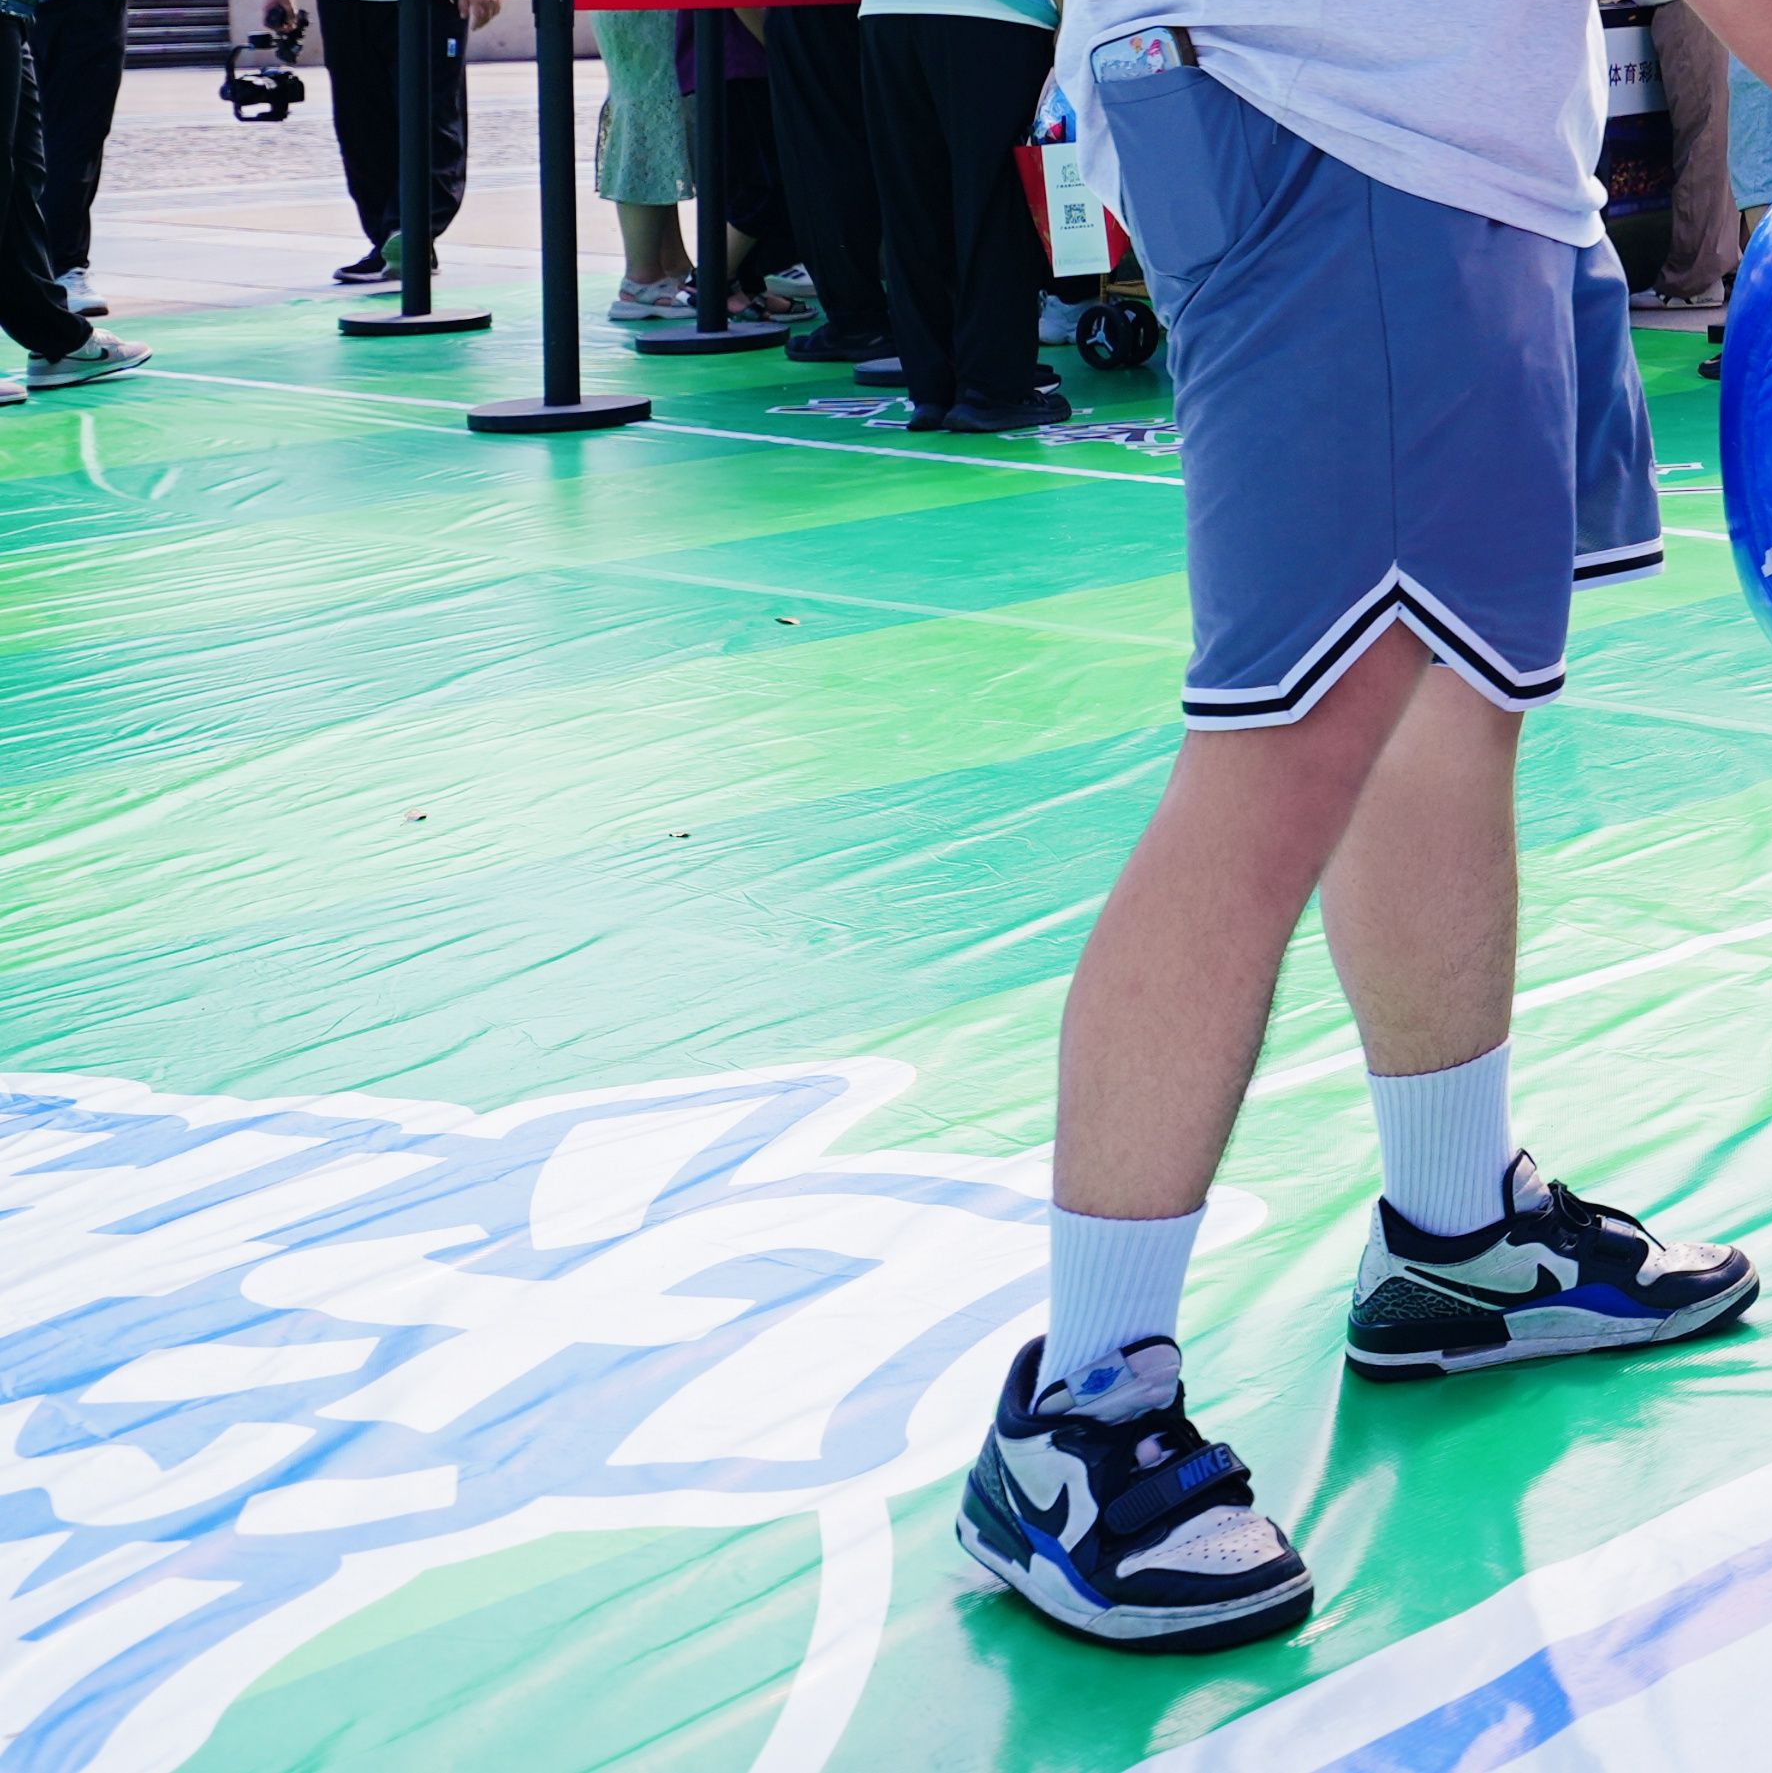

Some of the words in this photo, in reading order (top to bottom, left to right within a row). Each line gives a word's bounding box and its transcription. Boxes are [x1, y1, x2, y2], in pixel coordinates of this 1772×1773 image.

[1608, 60, 1662, 87] 体育彩
[1175, 1444, 1233, 1493] NIKE
